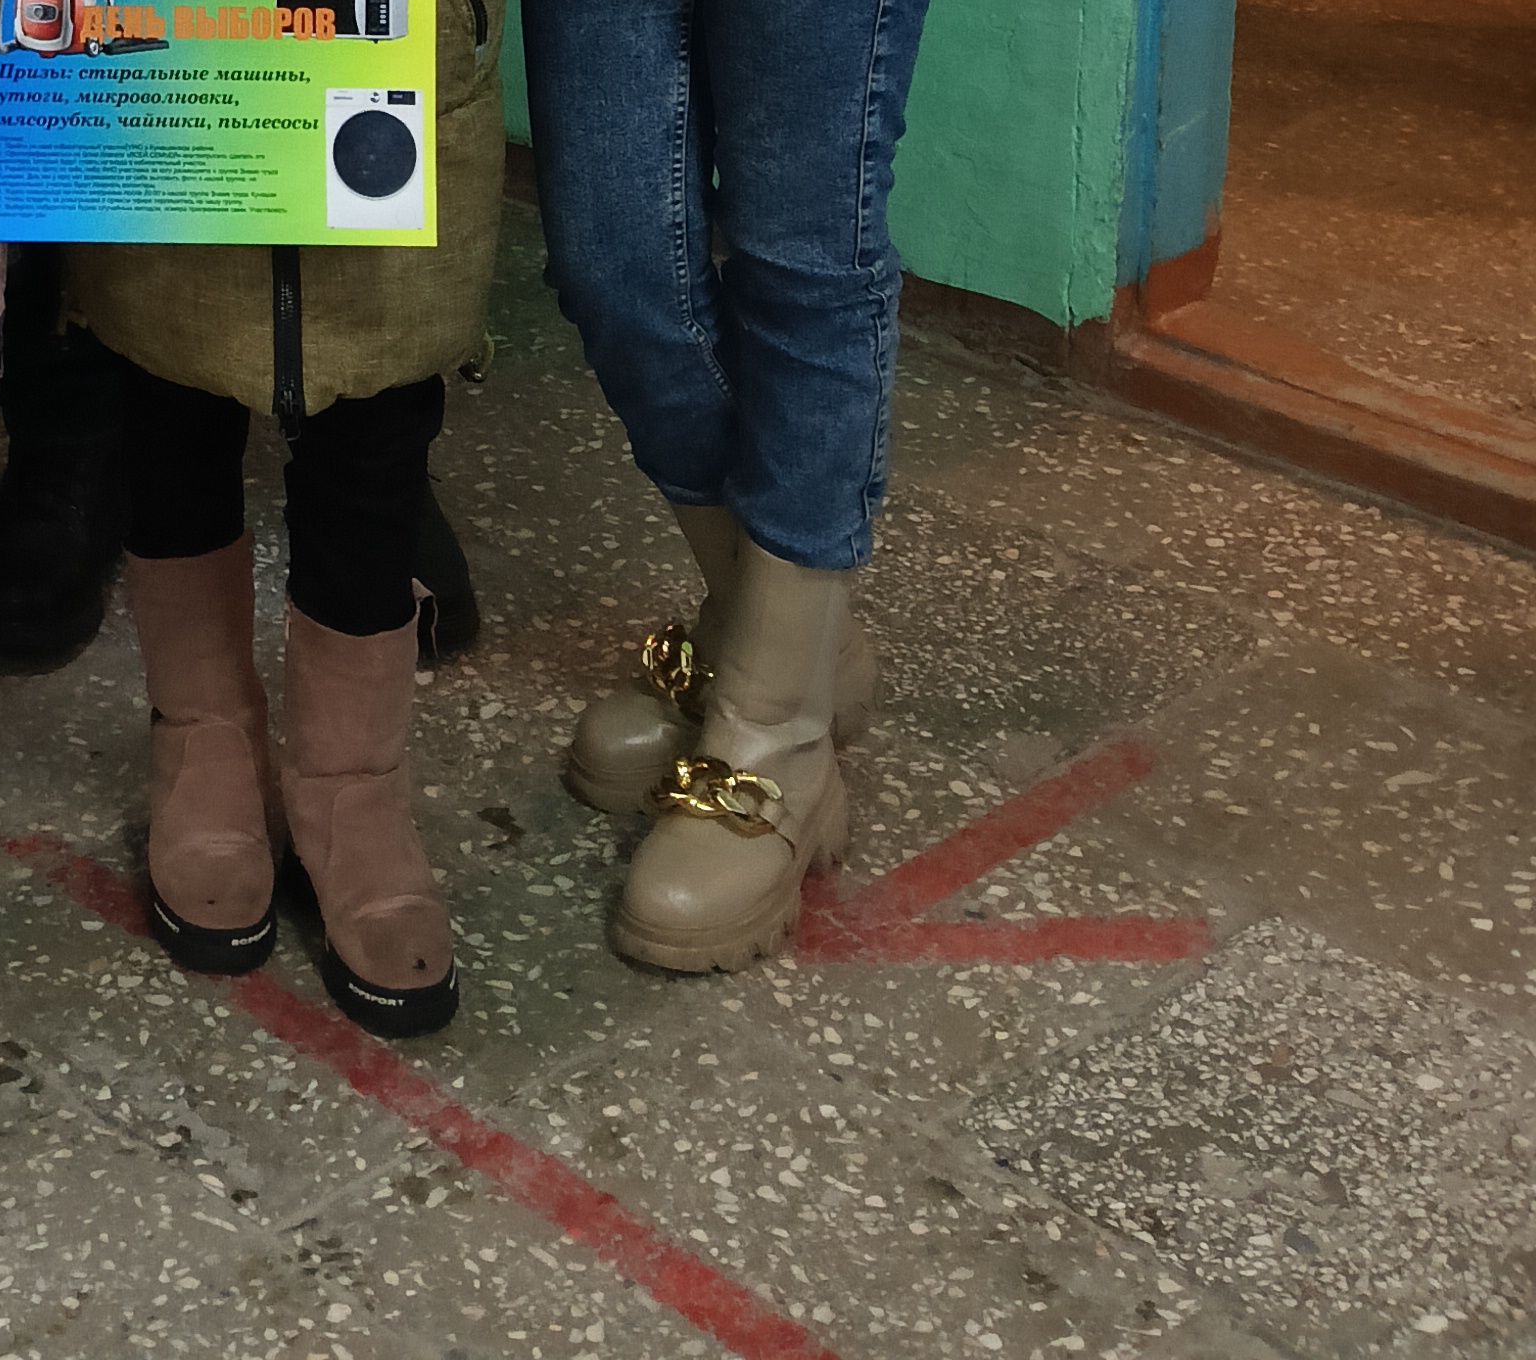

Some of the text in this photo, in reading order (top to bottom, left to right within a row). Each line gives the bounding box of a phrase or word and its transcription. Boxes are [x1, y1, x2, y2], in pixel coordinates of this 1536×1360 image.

[80, 5, 336, 44] ДЕНЬ ВЫБОРОВ
[79, 68, 209, 82] стиральные
[214, 68, 311, 85] машины,
[74, 91, 240, 107] микроволновки,
[116, 112, 212, 131] чайники,
[218, 116, 319, 131] пылесосы
